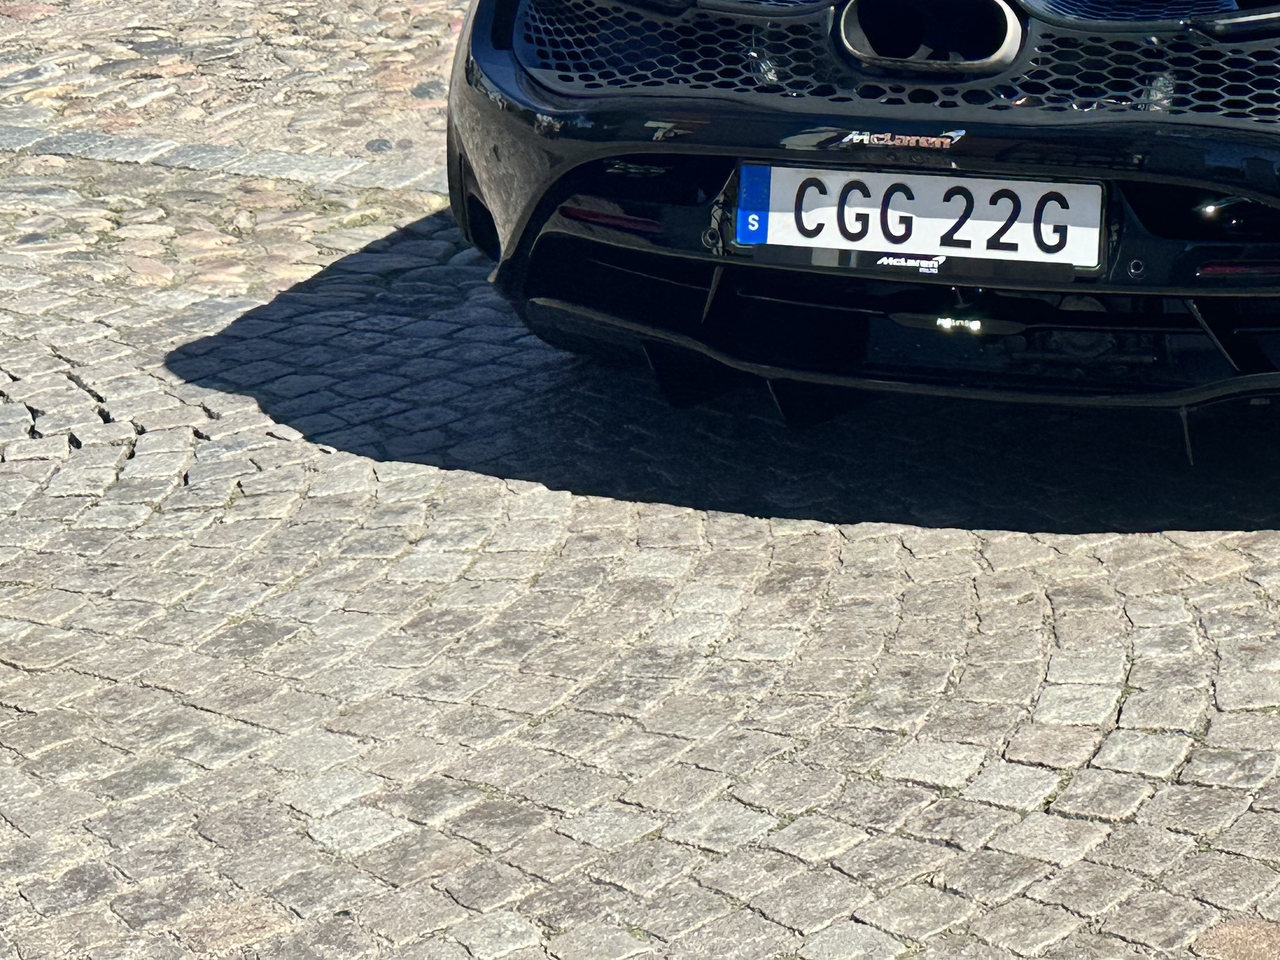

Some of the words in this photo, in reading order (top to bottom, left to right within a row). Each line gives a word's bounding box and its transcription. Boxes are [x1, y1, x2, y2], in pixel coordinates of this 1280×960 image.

[748, 214, 760, 231] S
[794, 177, 916, 245] CGG
[939, 185, 1070, 254] 22G
